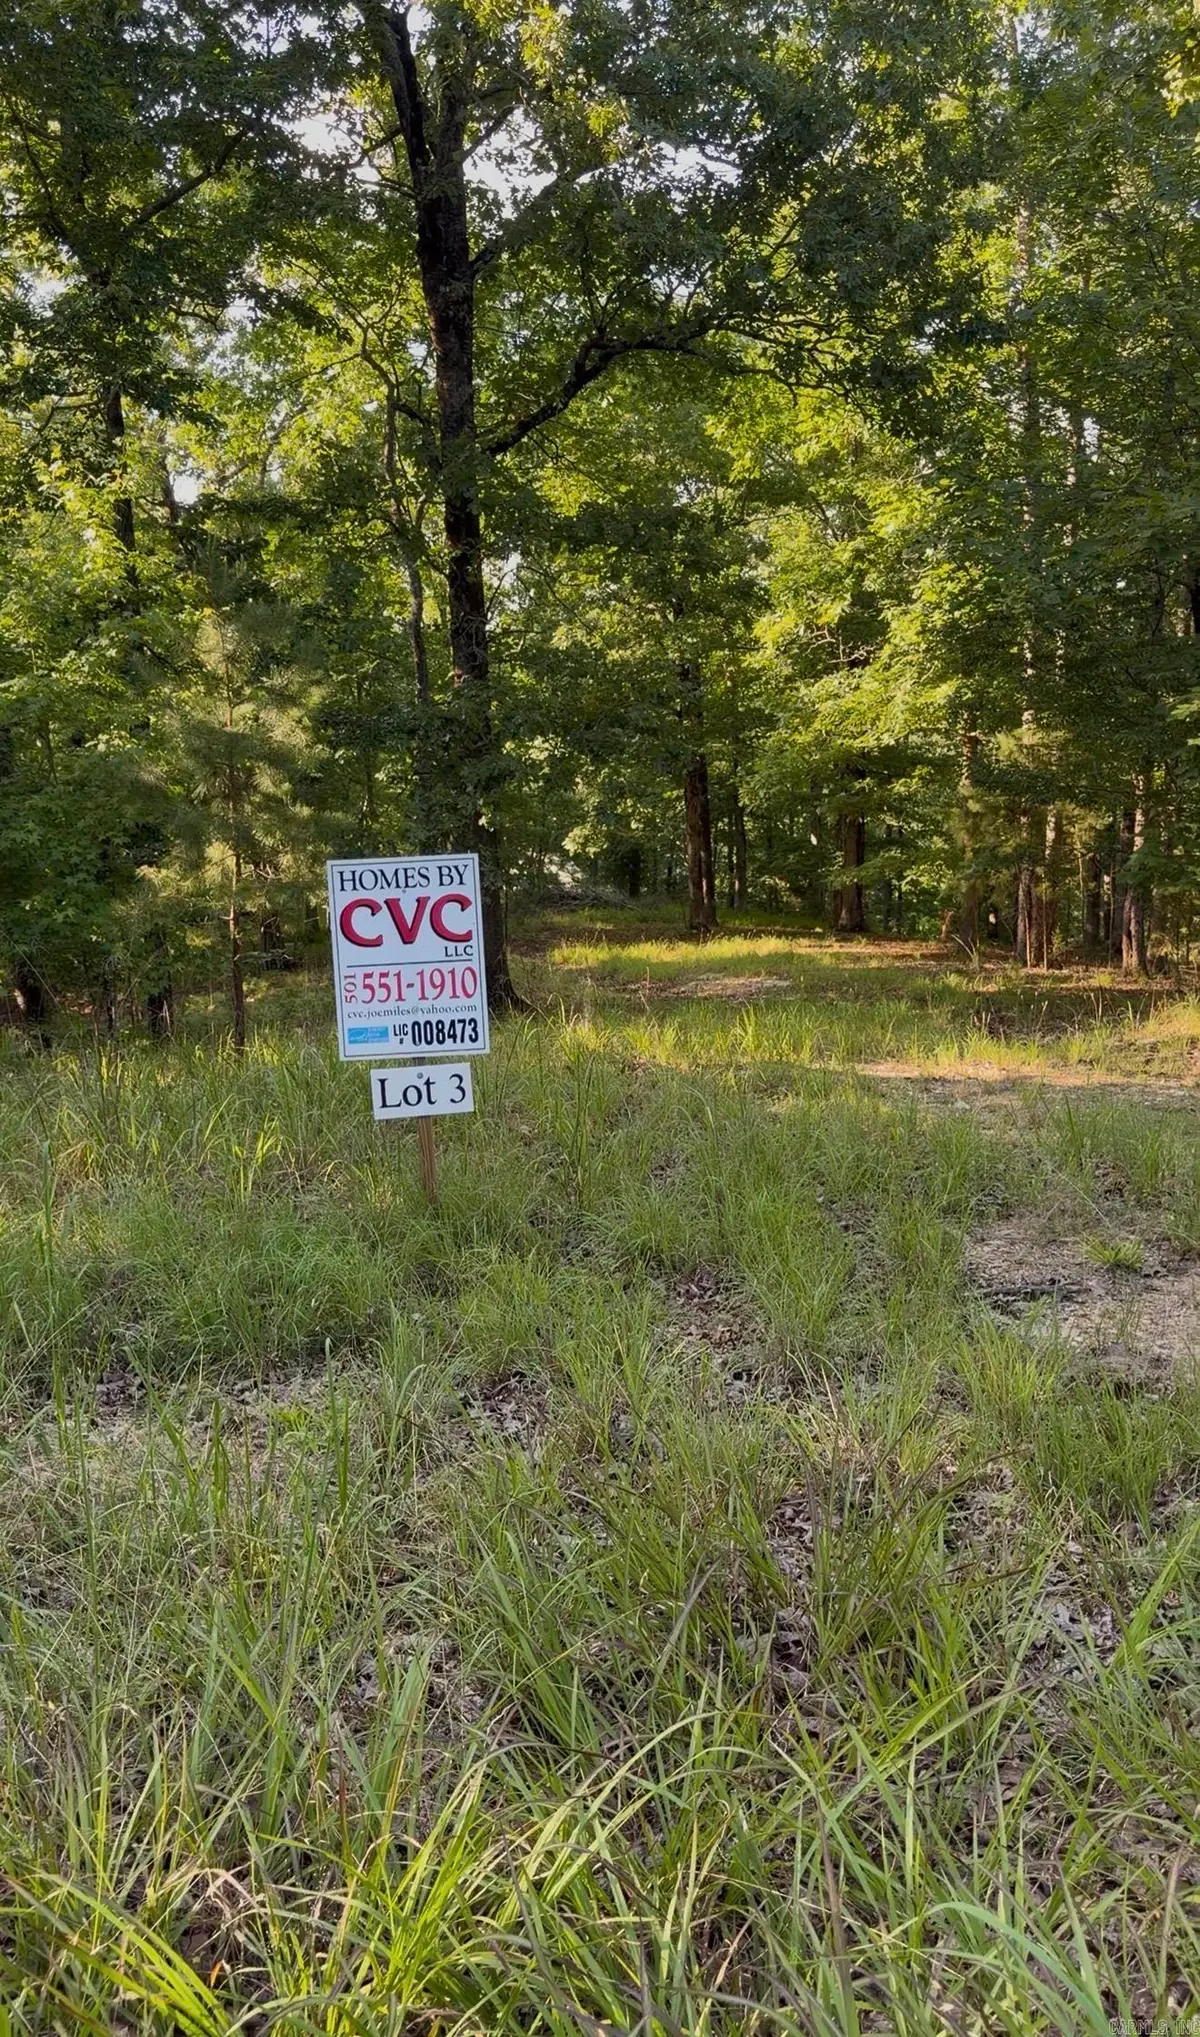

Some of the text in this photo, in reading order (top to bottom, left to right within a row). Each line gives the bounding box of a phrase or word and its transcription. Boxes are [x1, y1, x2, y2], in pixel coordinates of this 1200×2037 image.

[338, 864, 469, 892] HOMES BY
[339, 893, 473, 948] CVC
[444, 945, 474, 957] LLC
[343, 972, 358, 1004] 501
[361, 966, 478, 1004] 551-1910
[347, 1003, 477, 1019] cvc.joemiles@yahoo.com
[393, 1023, 409, 1037] LIC
[411, 1018, 479, 1047] 008473
[377, 1073, 466, 1108] Lot 3
